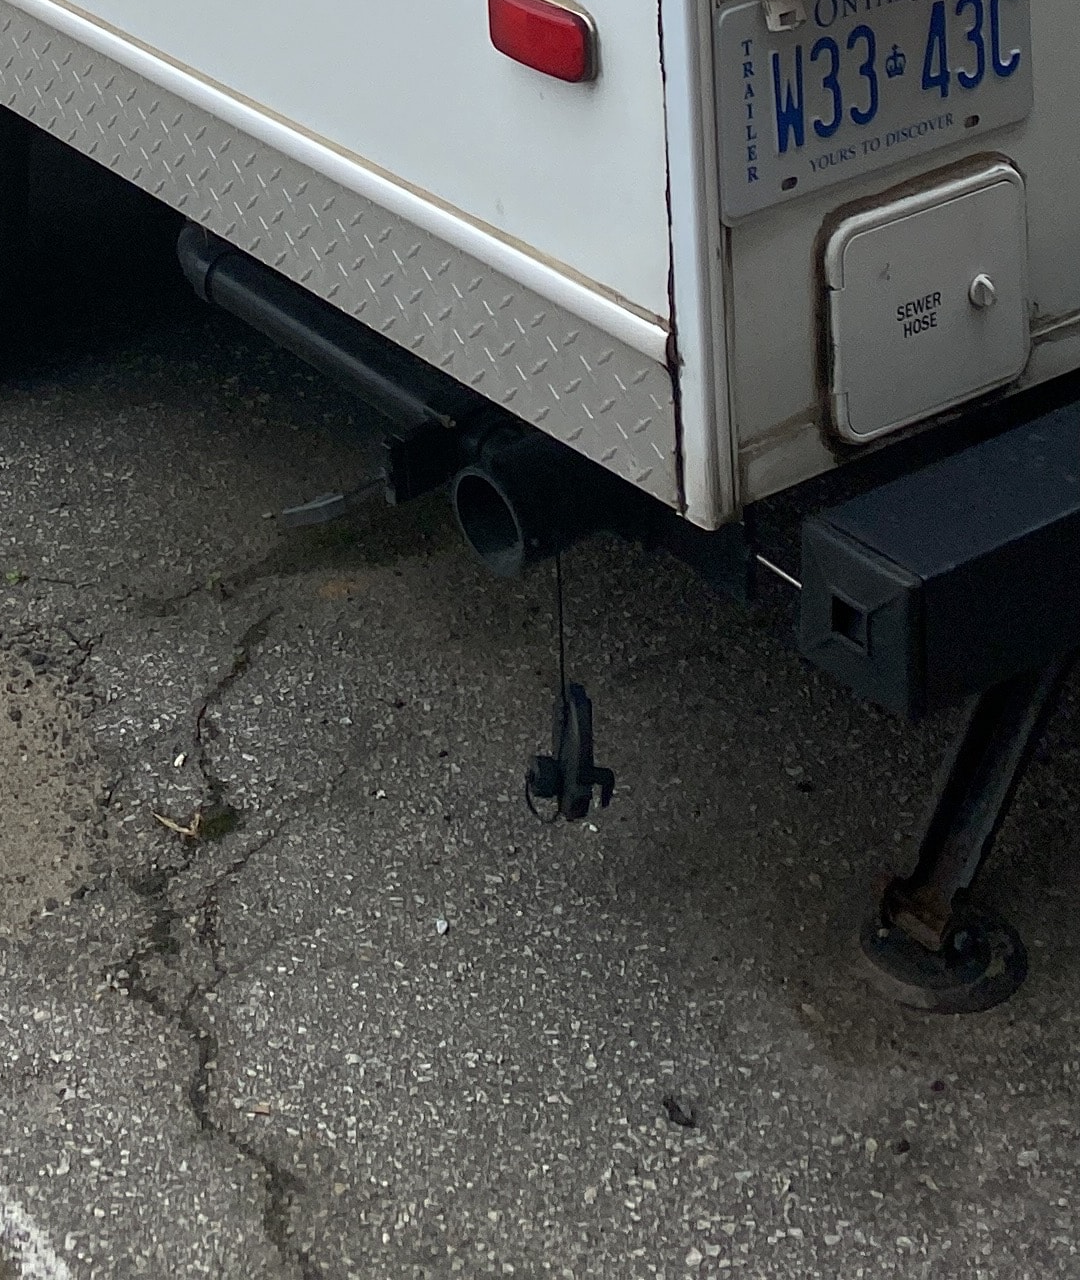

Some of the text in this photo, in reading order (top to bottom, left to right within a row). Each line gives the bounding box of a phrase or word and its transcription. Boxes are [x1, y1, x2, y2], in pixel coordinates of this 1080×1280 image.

[741, 39, 759, 184] TRAILER
[772, 24, 879, 154] W33
[809, 112, 954, 173] YOURS TO DISCOVER
[897, 291, 941, 321] SEWER
[903, 311, 937, 338] HOSE
